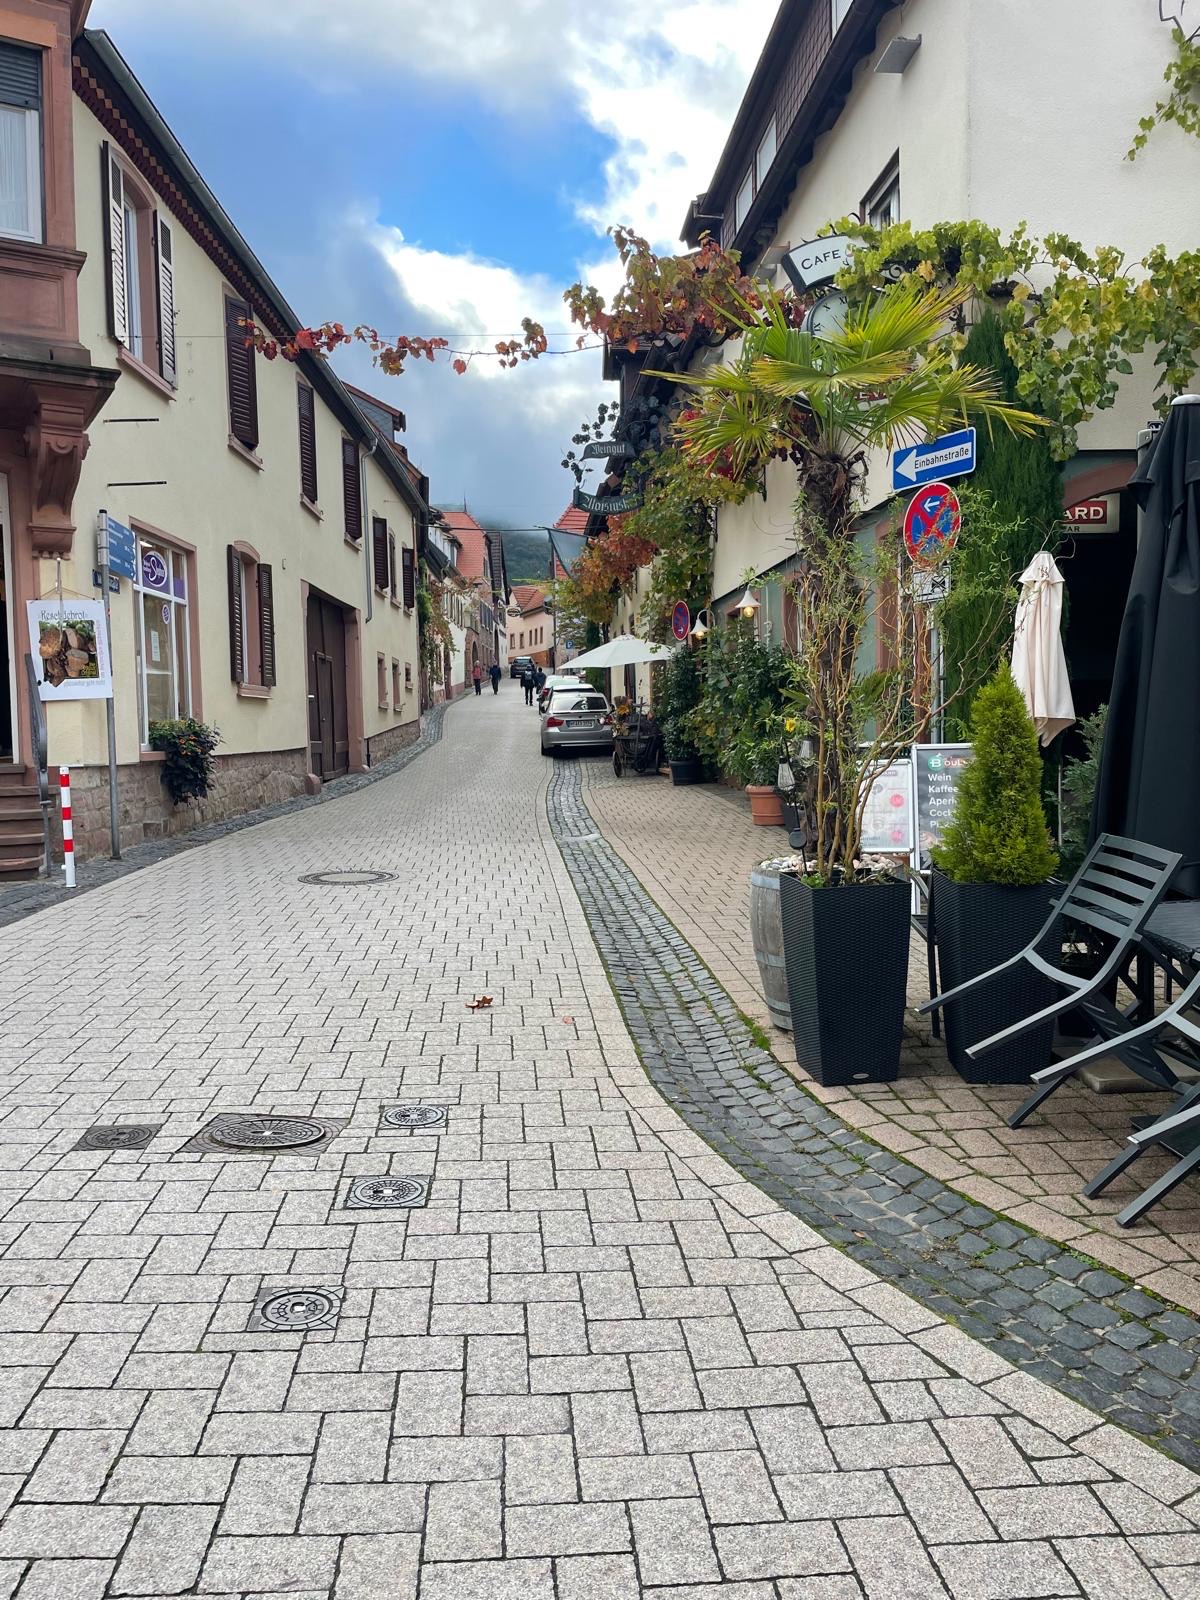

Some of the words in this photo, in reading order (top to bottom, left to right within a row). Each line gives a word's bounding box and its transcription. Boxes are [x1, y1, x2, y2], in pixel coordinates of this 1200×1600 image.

[801, 249, 841, 270] CAFE
[592, 443, 625, 454] Weingut
[914, 447, 969, 469] Einbahnstraße
[928, 773, 951, 781] Wein
[928, 785, 959, 793] Kaffee
